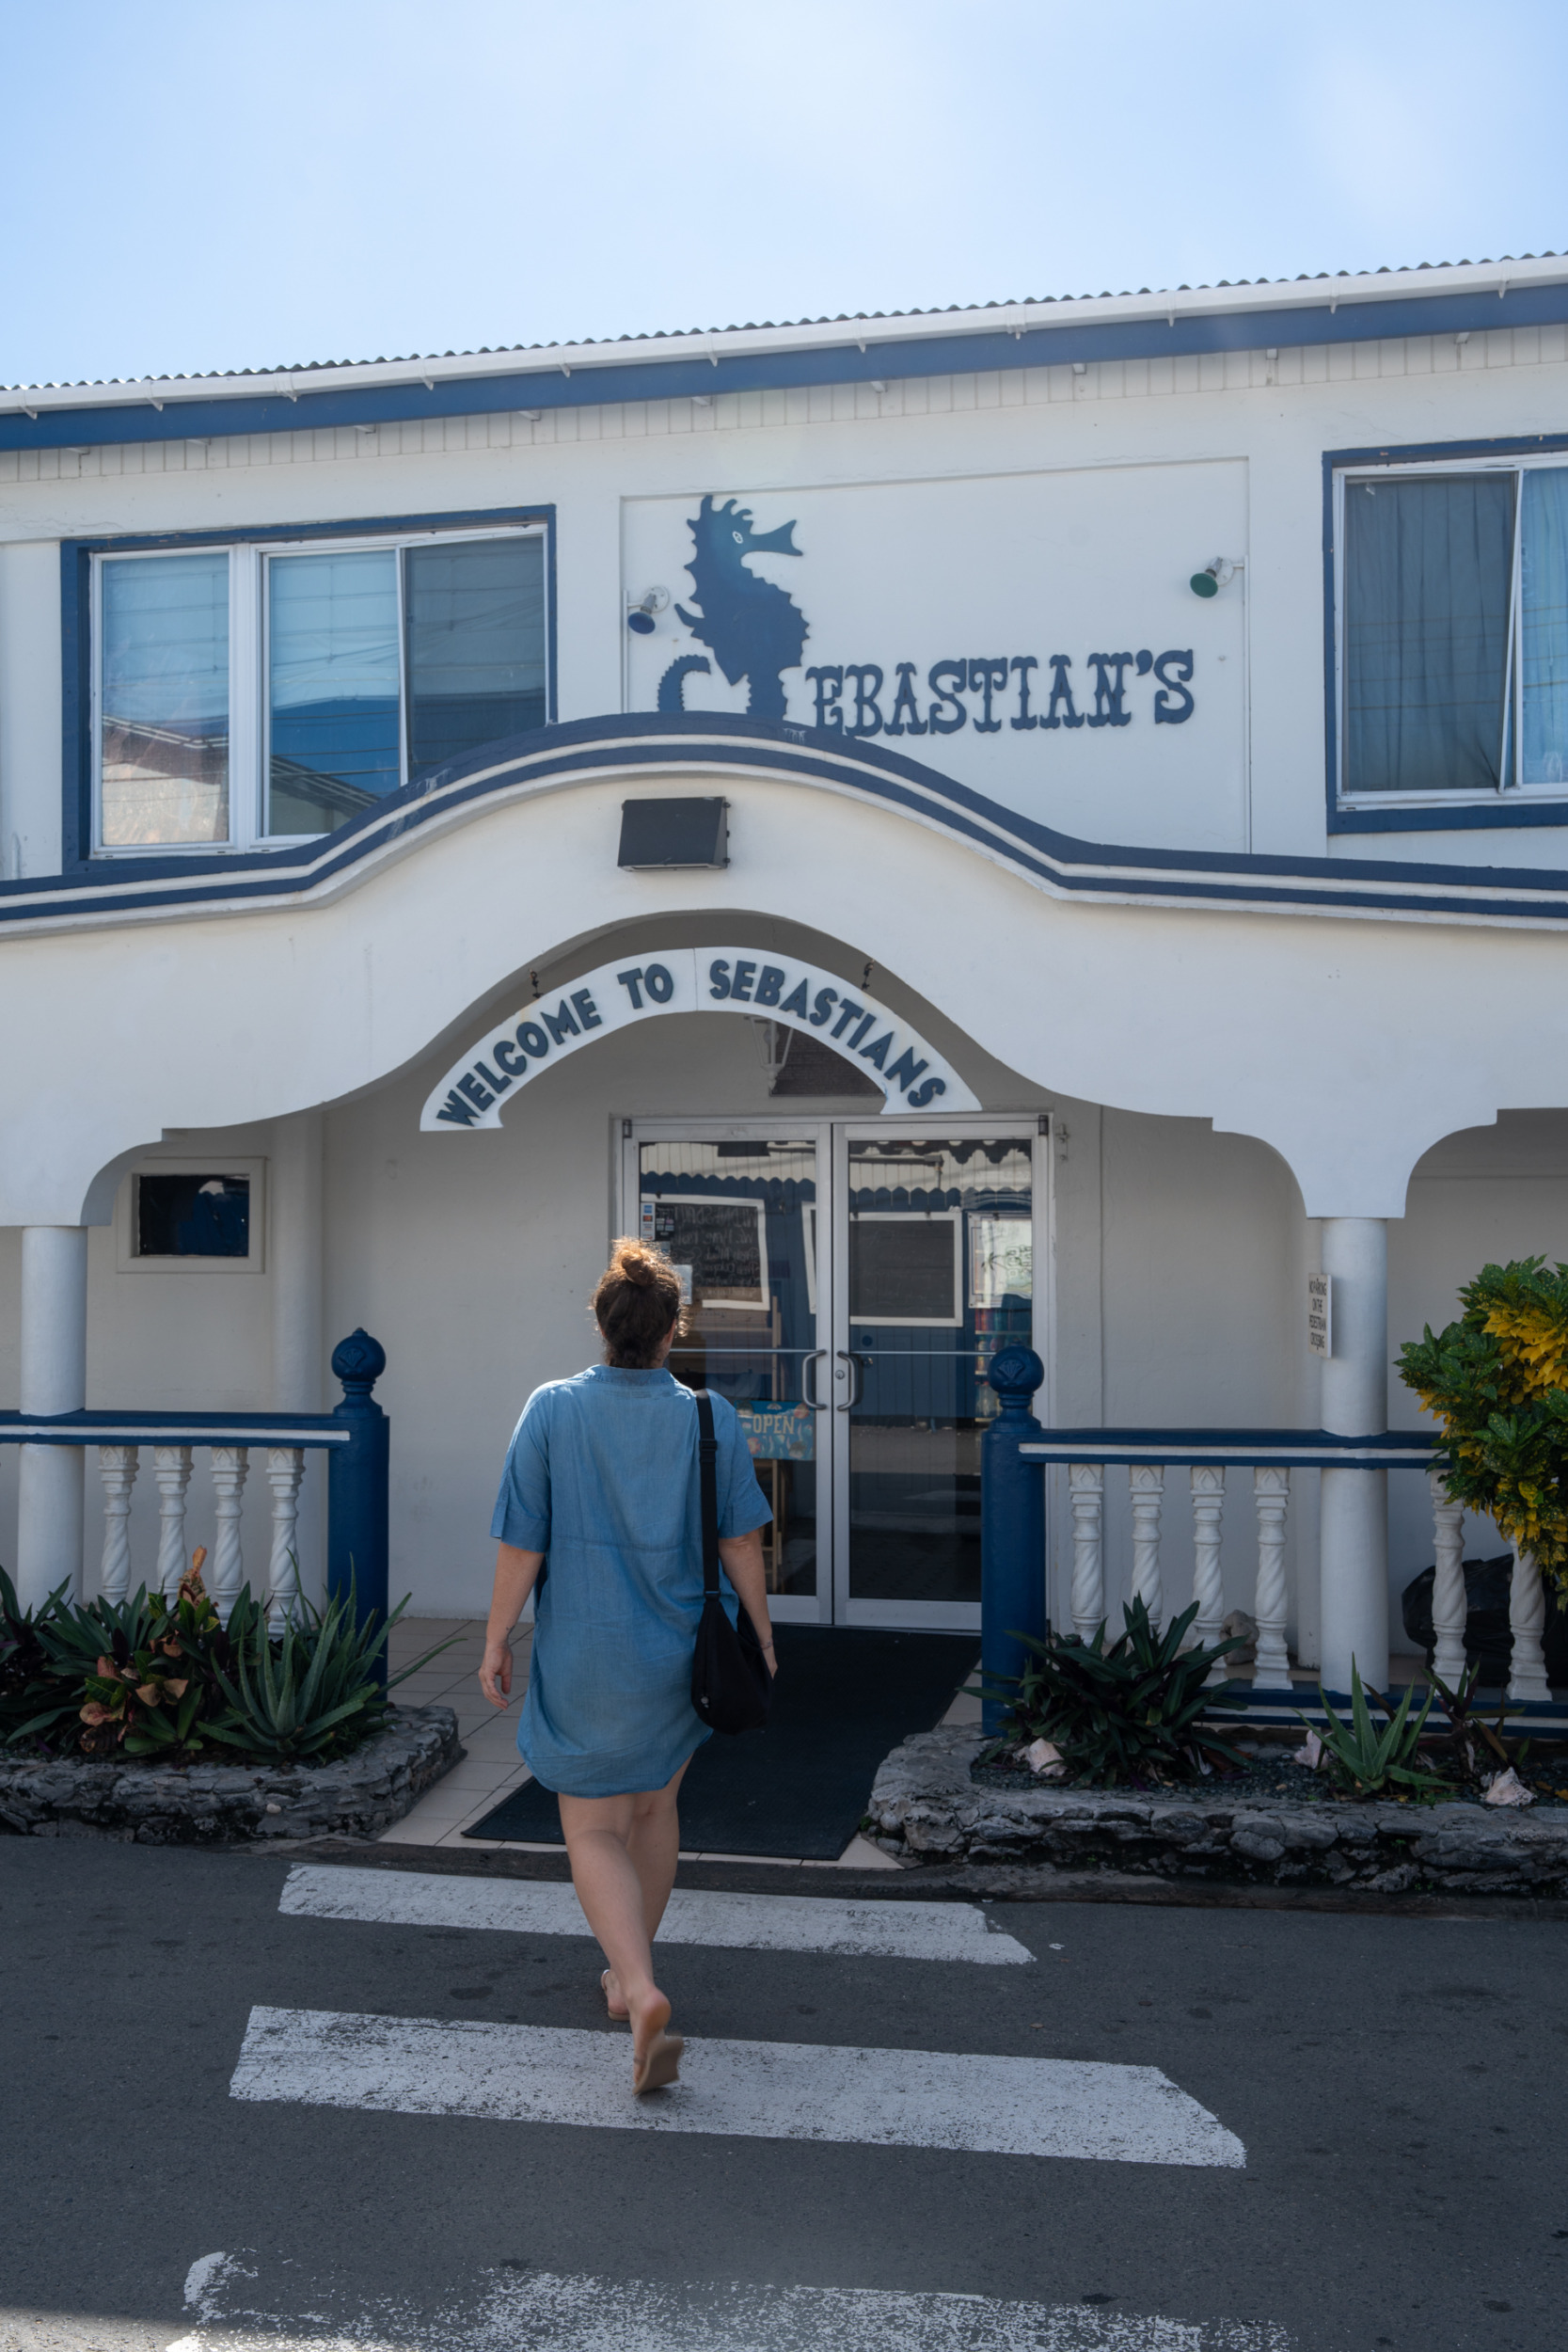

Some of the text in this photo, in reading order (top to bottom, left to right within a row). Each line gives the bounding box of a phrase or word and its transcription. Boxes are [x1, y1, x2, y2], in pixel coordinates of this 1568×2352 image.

[436, 960, 946, 1127] WELCOME TO SEBASTIANS
[752, 1414, 795, 1435] OPEN
